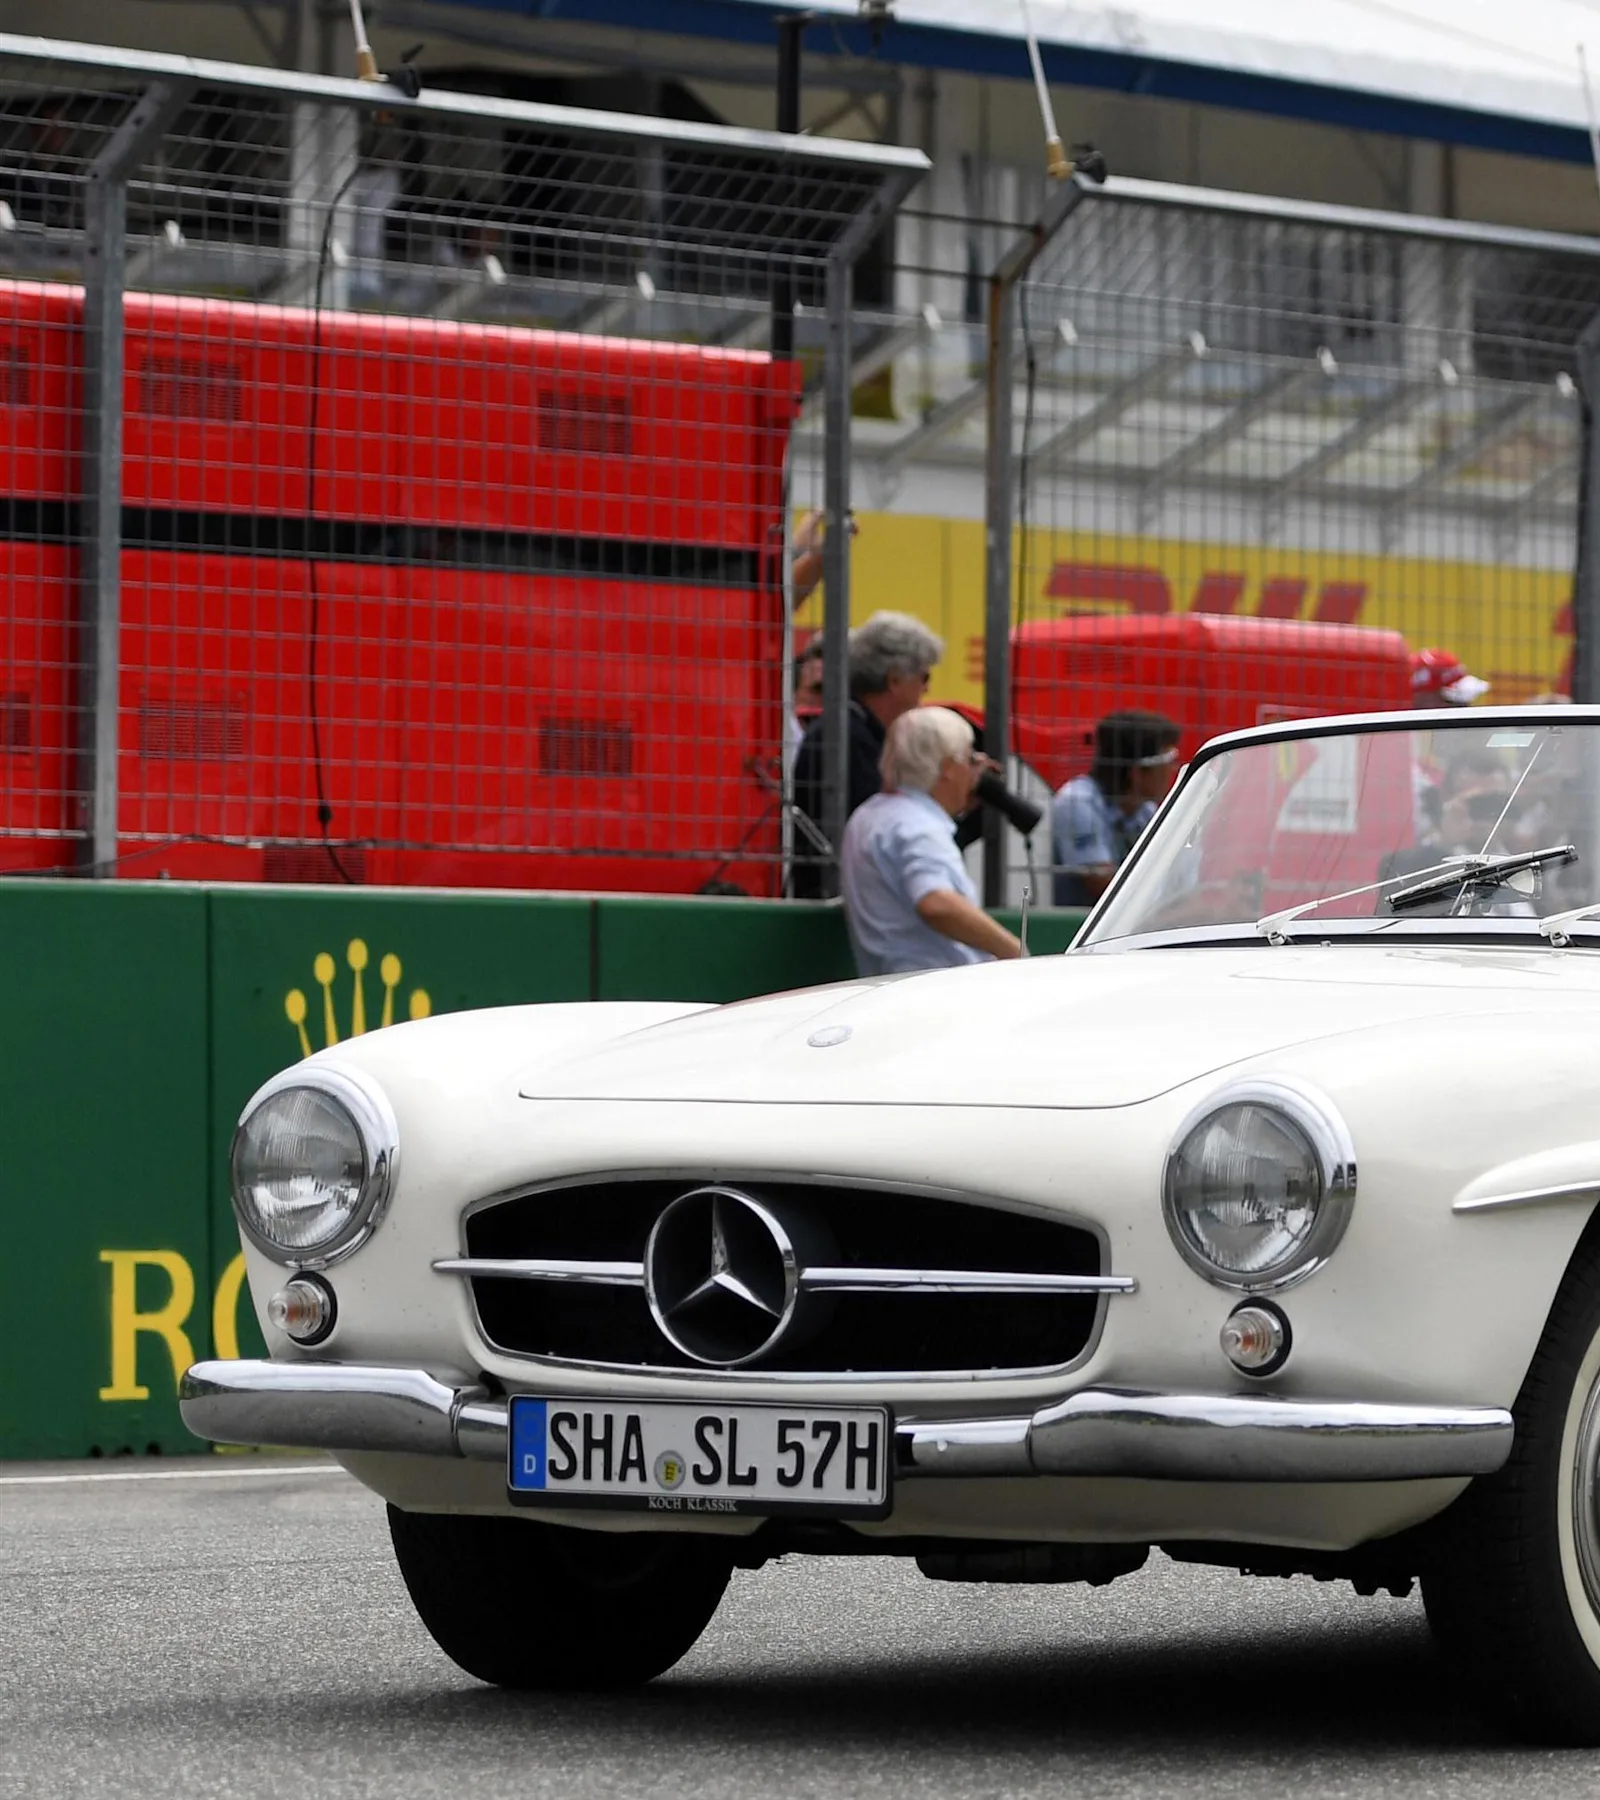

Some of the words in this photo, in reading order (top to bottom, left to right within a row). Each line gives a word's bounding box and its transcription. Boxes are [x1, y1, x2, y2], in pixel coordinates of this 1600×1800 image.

[548, 1411, 648, 1483] SHA
[692, 1416, 758, 1487] SL
[776, 1419, 879, 1491] 57H
[523, 1454, 536, 1475] D
[648, 1496, 682, 1510] KOCH
[686, 1498, 739, 1512] KLASSIK
